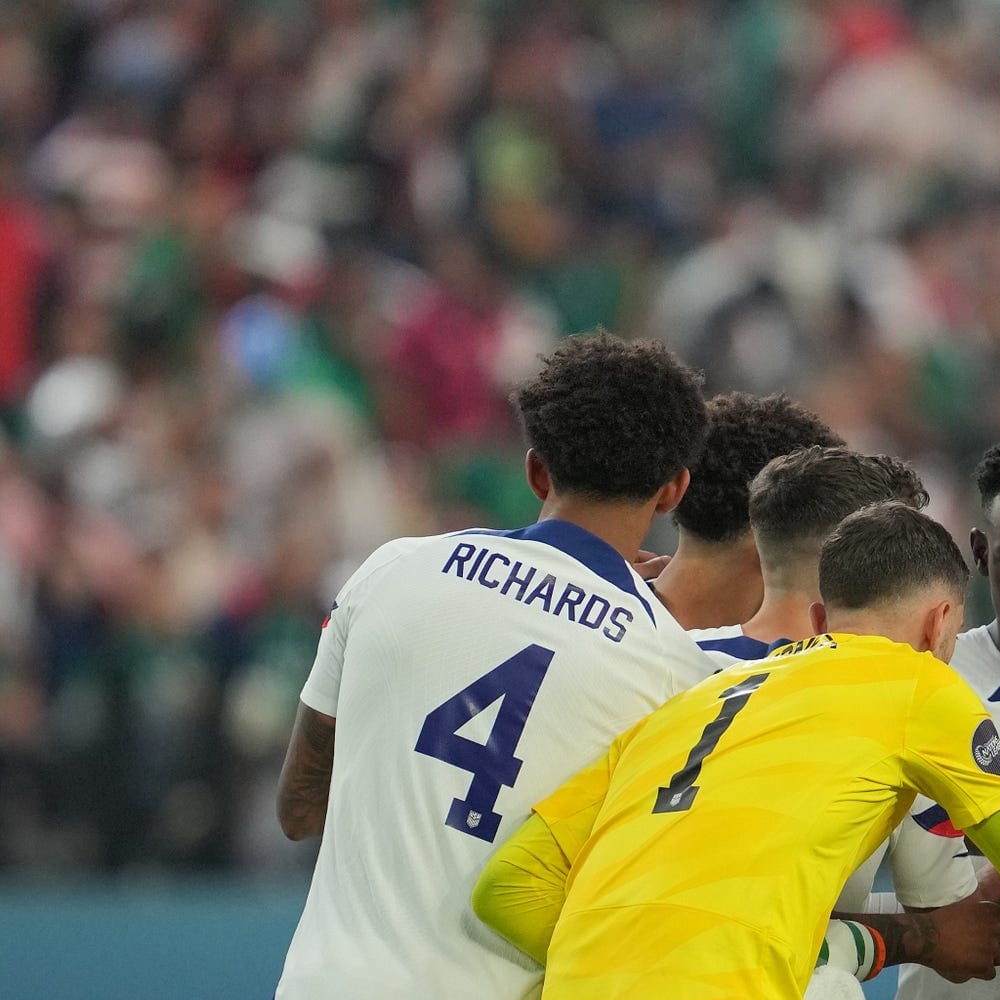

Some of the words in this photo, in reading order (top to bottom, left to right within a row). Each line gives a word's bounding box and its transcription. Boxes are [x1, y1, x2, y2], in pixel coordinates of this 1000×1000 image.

[441, 542, 635, 643] RICHARDS
[413, 643, 556, 844] 4
[651, 671, 771, 815] 1
